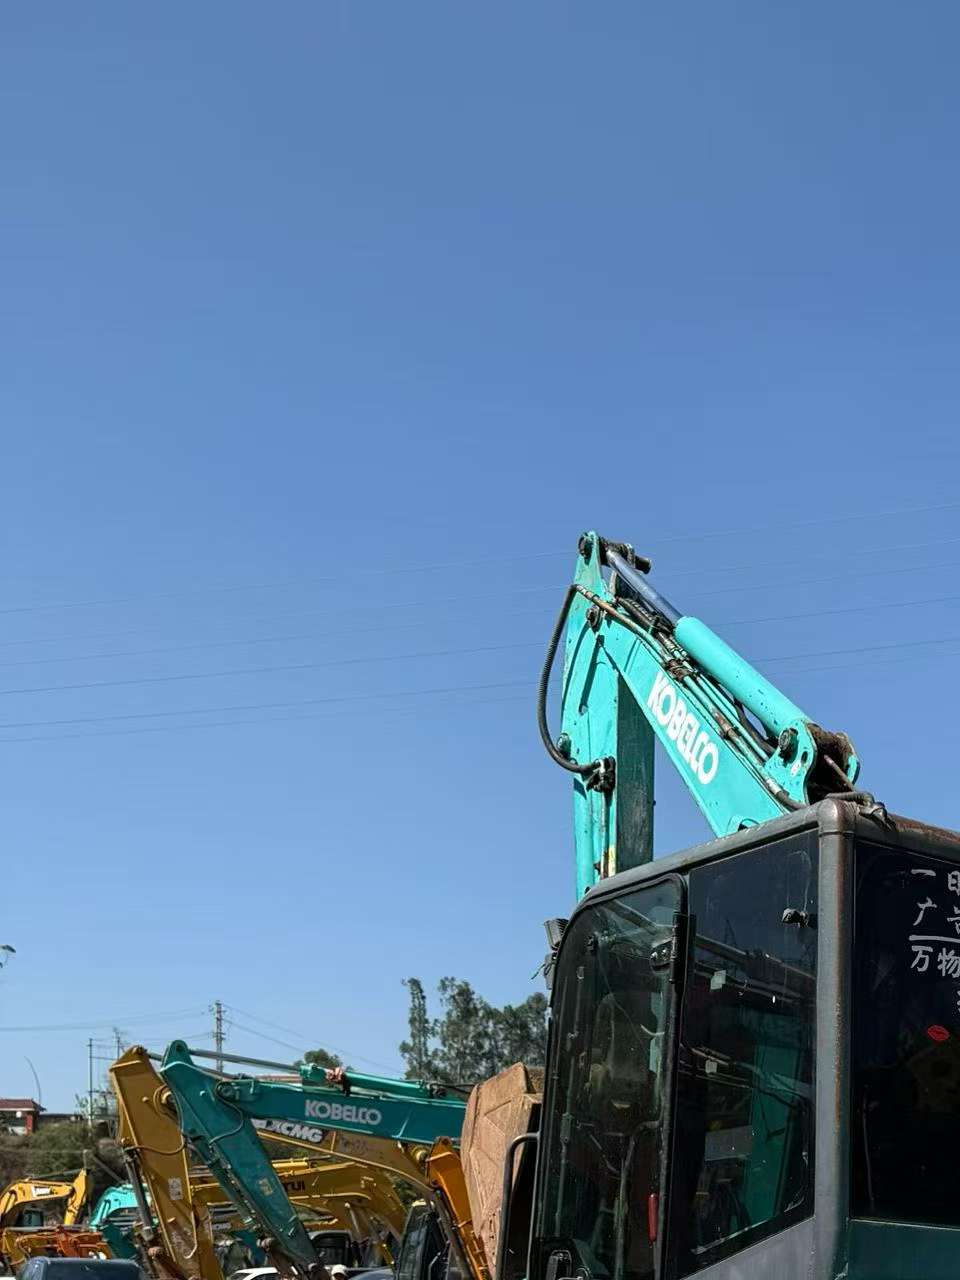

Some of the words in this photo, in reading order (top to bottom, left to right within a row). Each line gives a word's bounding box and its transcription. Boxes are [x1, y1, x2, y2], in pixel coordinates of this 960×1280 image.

[647, 670, 719, 785] KOBELCO
[305, 1099, 382, 1126] KOBELCO
[267, 1121, 324, 1143] XCMG
